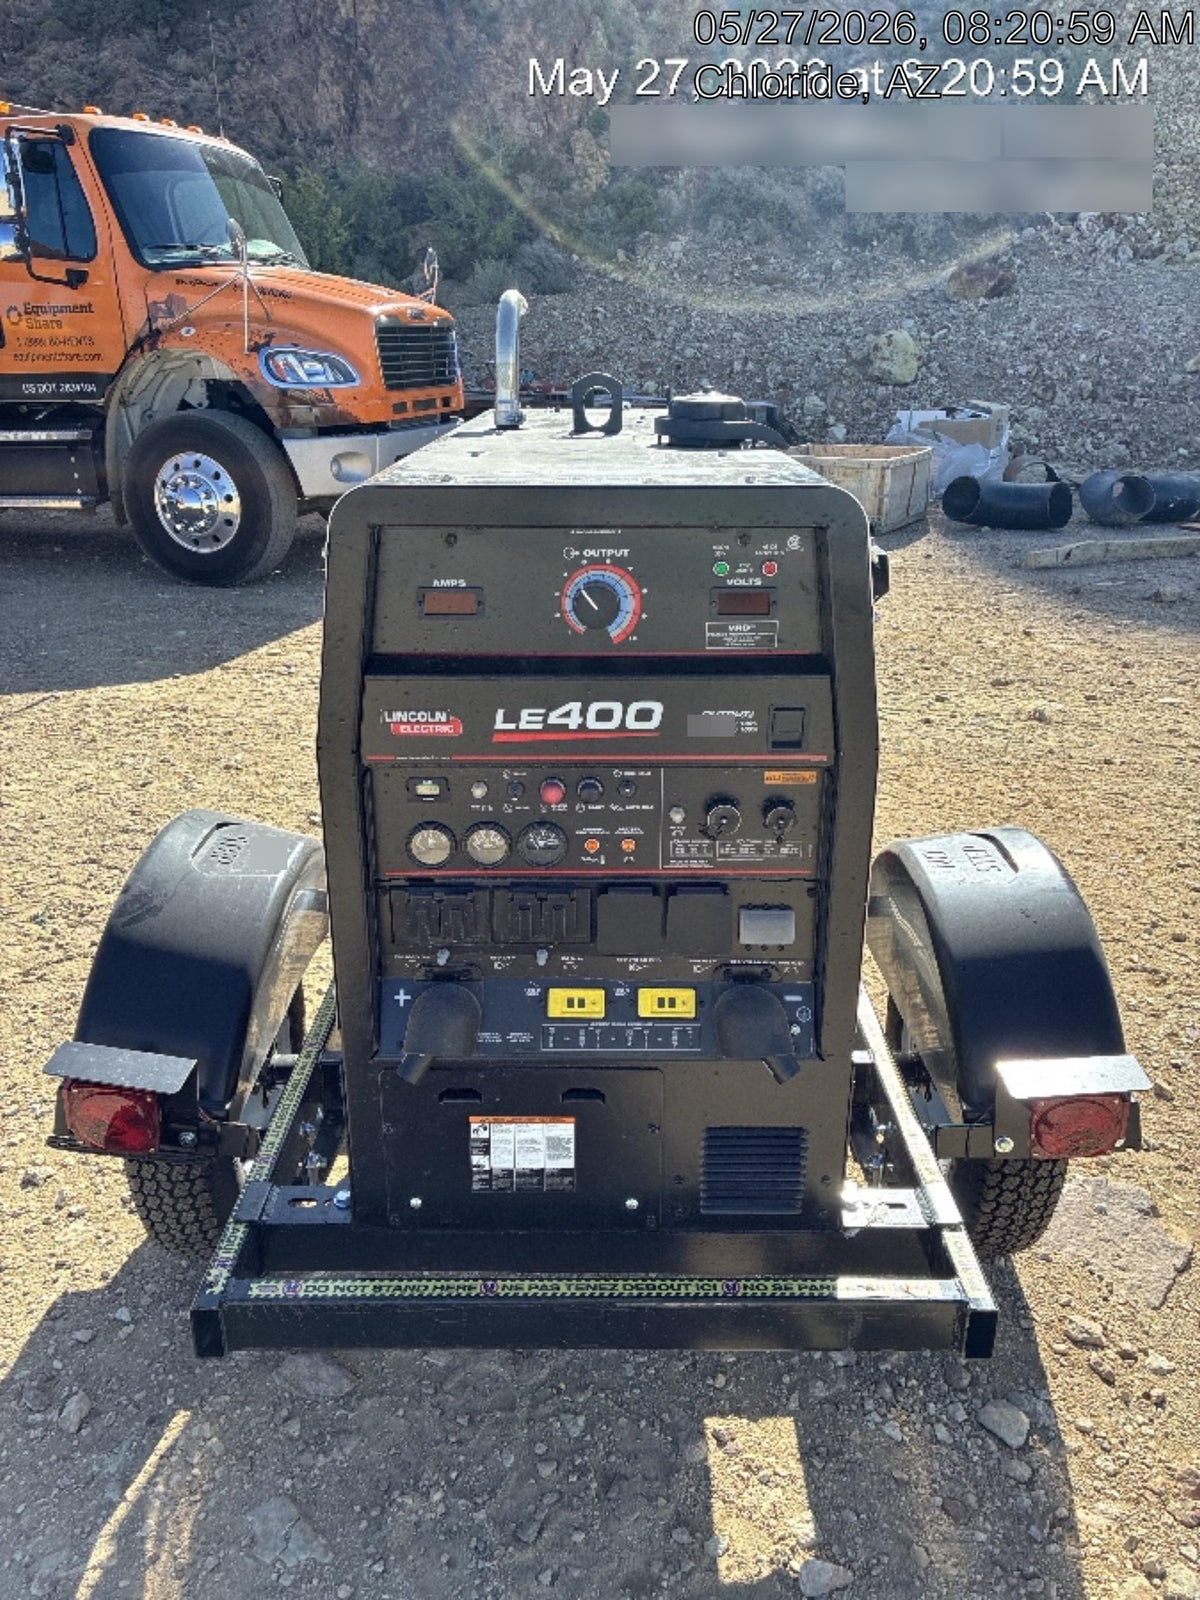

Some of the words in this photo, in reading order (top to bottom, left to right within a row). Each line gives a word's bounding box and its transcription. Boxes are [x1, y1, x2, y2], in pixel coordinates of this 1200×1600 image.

[23, 302, 94, 317] Equipment
[26, 317, 63, 329] Share
[582, 548, 630, 557] OUTPUT
[432, 579, 467, 588] AMPS
[726, 577, 762, 586] VOLTS
[384, 710, 448, 723] LINCOLN
[494, 701, 664, 730] LE400
[400, 724, 454, 734] ELECTRIC
[303, 1284, 330, 1293] DO
[333, 1284, 371, 1293] NOT
[371, 1284, 429, 1293] STAND
[432, 1283, 478, 1292] HERE
[501, 1283, 526, 1292] NE
[527, 1283, 561, 1292] PAS
[565, 1282, 619, 1291] TENEZ
[622, 1282, 692, 1291] DEBOUT
[695, 1282, 718, 1291] ICI
[743, 1283, 768, 1292] NO
